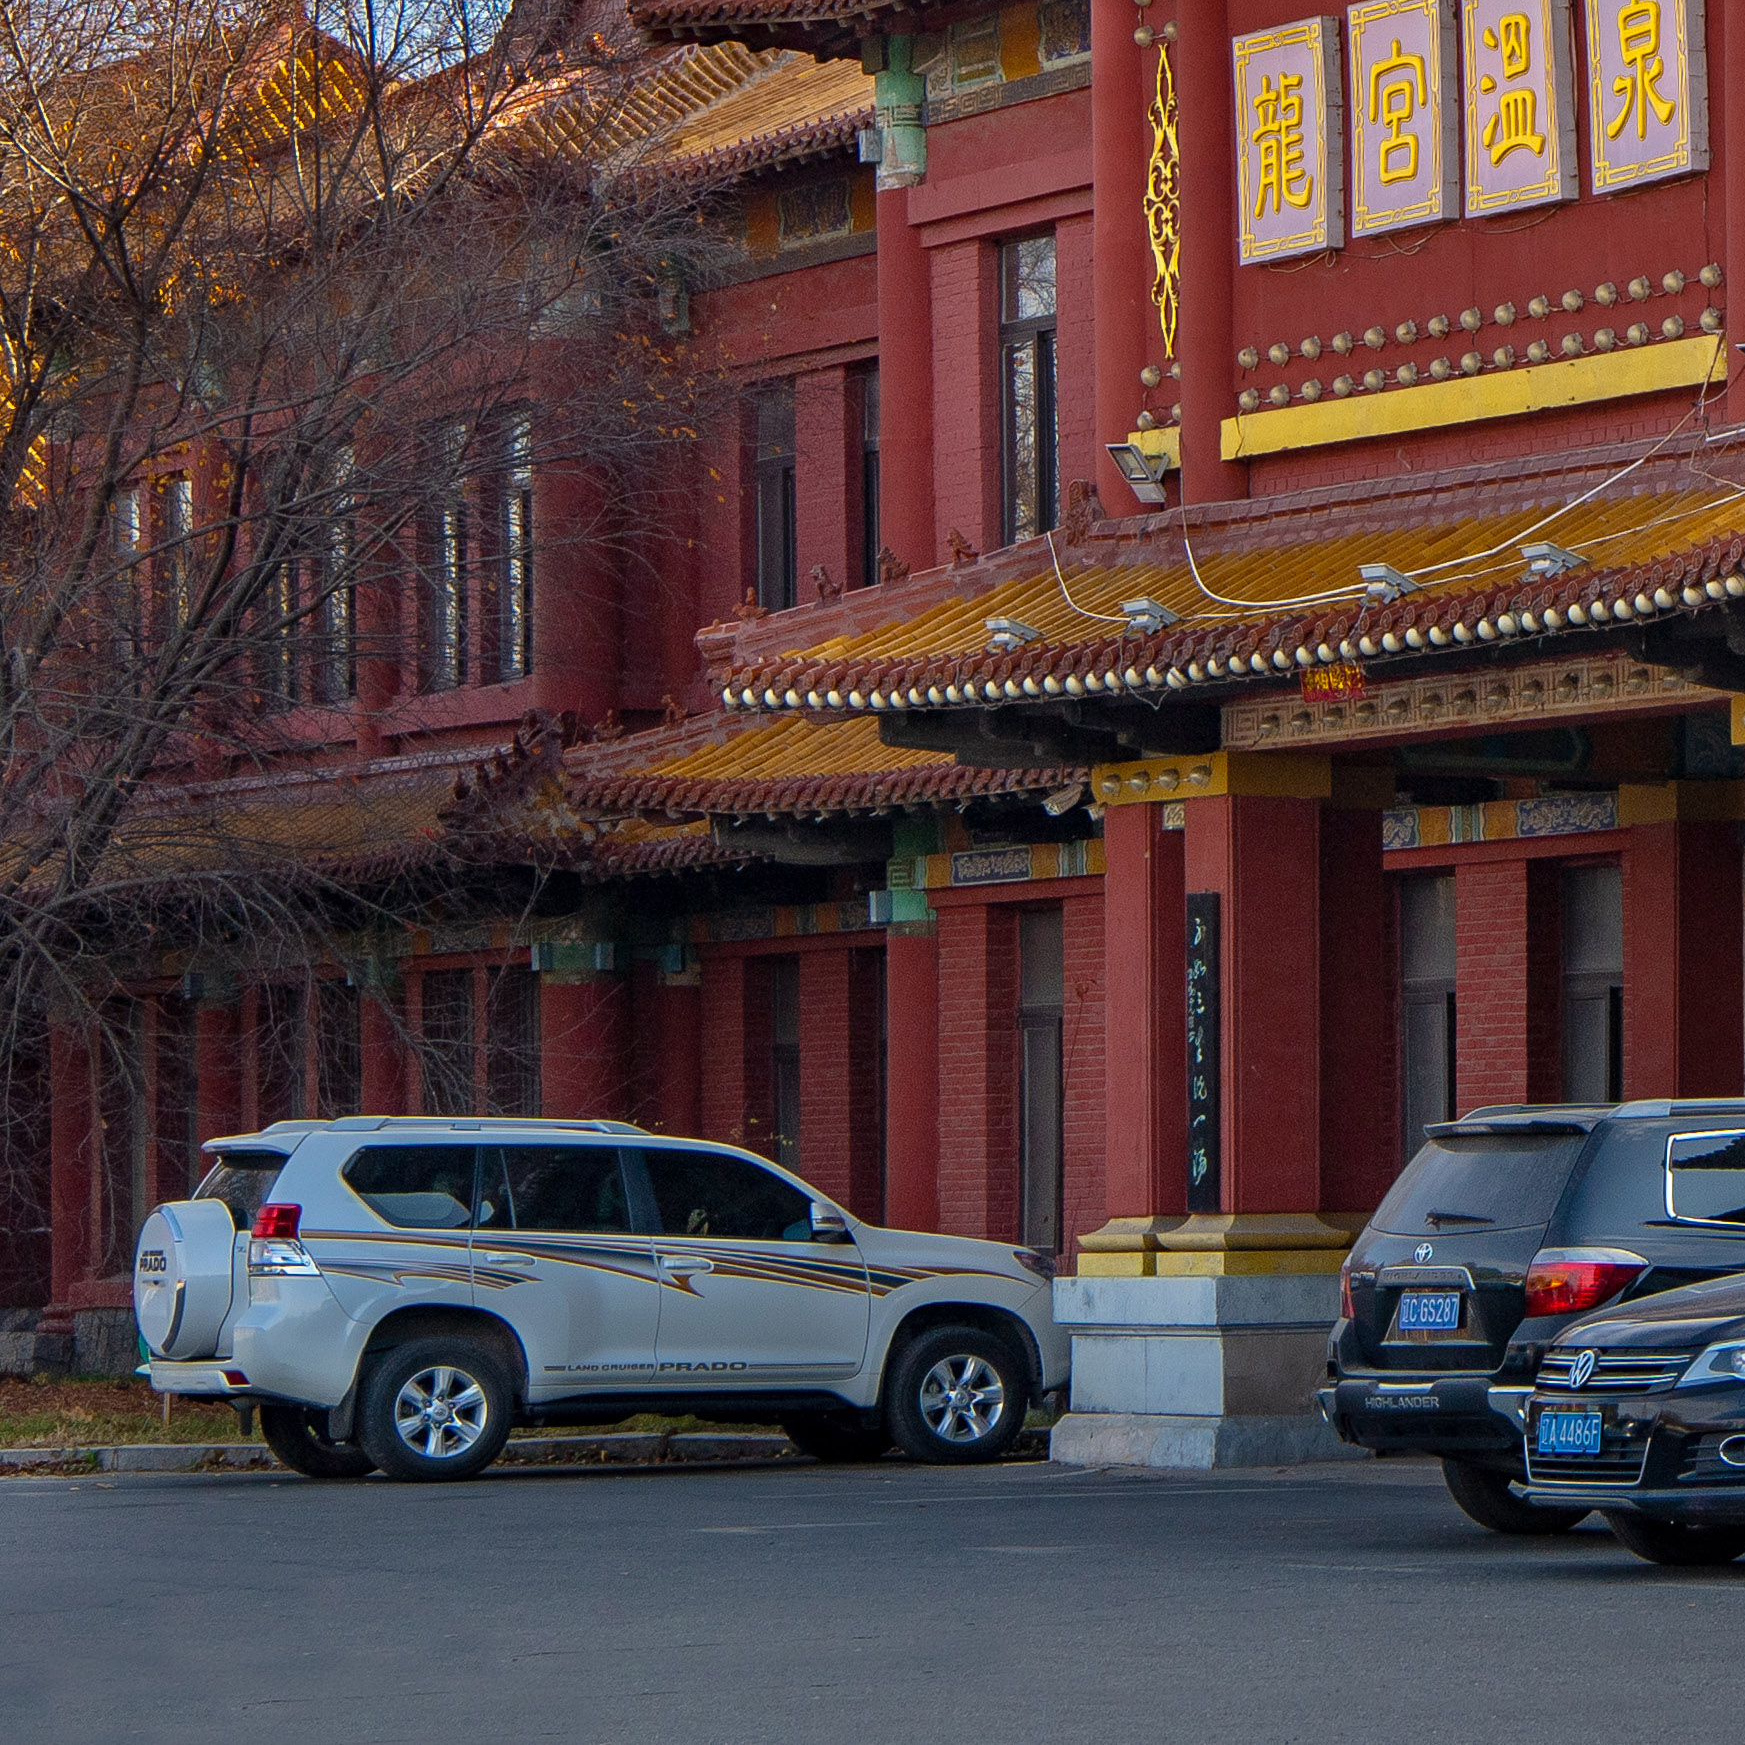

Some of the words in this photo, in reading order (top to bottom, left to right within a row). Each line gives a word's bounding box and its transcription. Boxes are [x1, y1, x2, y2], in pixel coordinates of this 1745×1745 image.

[140, 1257, 167, 1272] PRADO
[567, 1364, 599, 1372] LAND
[602, 1363, 655, 1372] CRUISER
[658, 1361, 748, 1372] PRADO
[1365, 1395, 1440, 1410] HIGHLANDER
